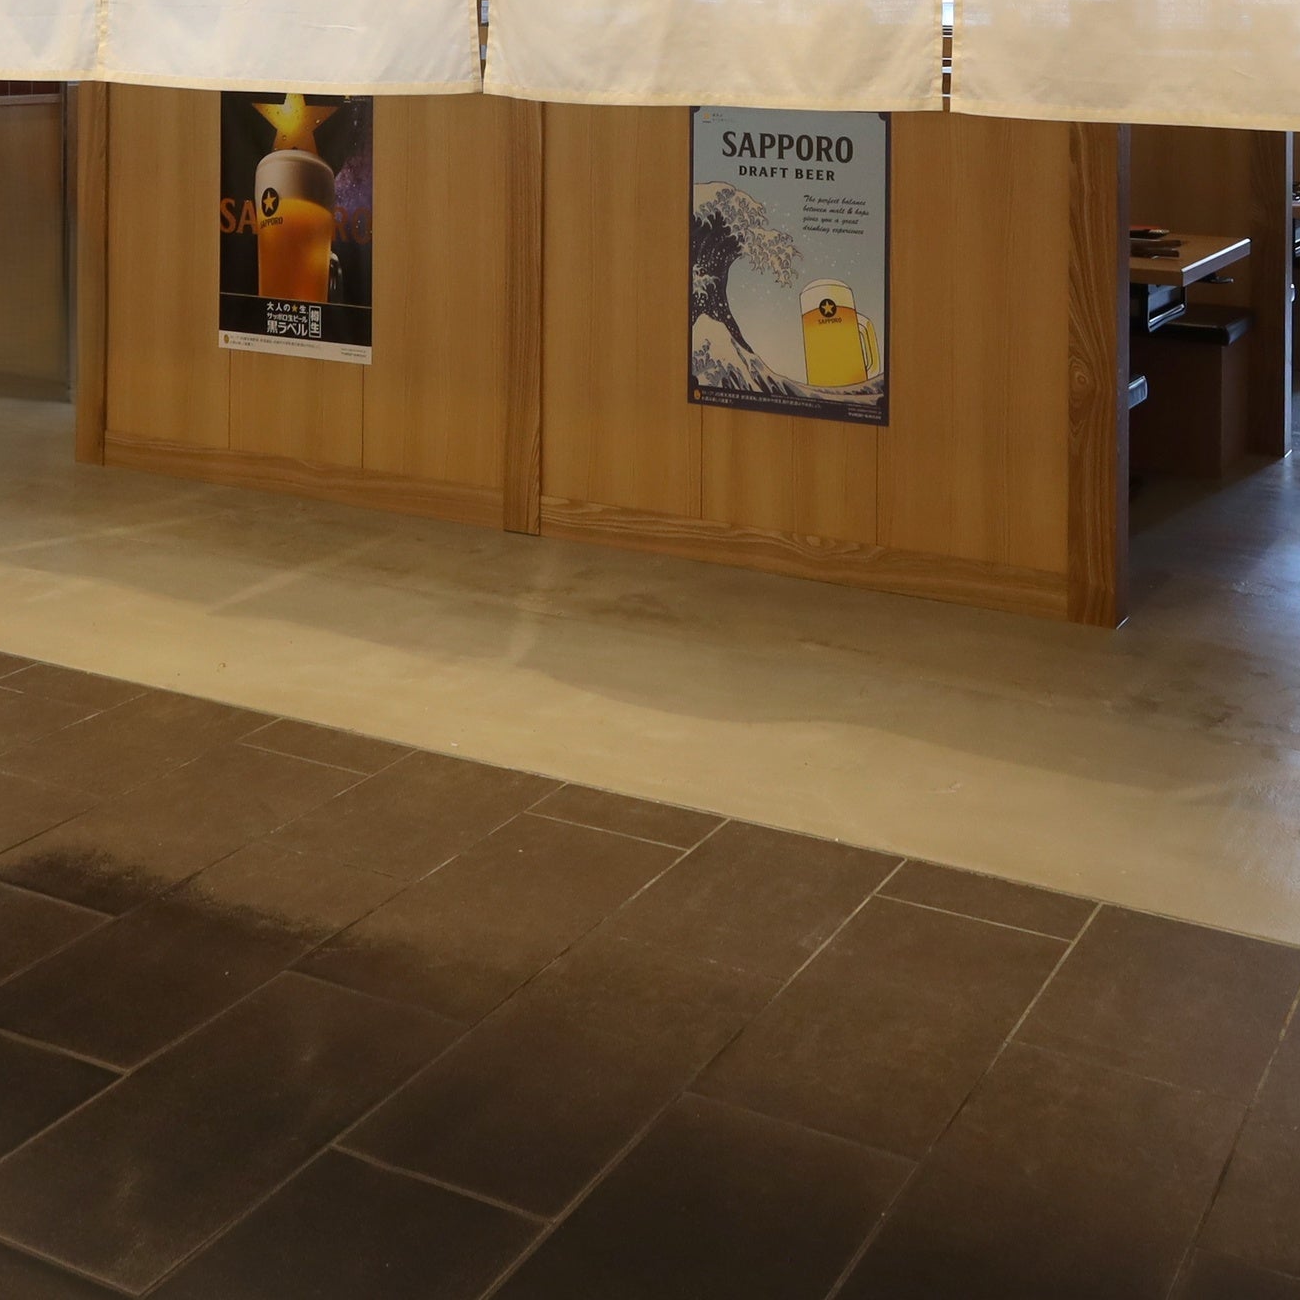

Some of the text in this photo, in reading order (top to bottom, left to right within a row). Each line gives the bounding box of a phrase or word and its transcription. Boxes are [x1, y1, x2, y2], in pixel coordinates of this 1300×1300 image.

[722, 130, 854, 163] SAPPORO
[739, 165, 836, 182] DRAFT BEER
[266, 320, 308, 336] 黒ラベル
